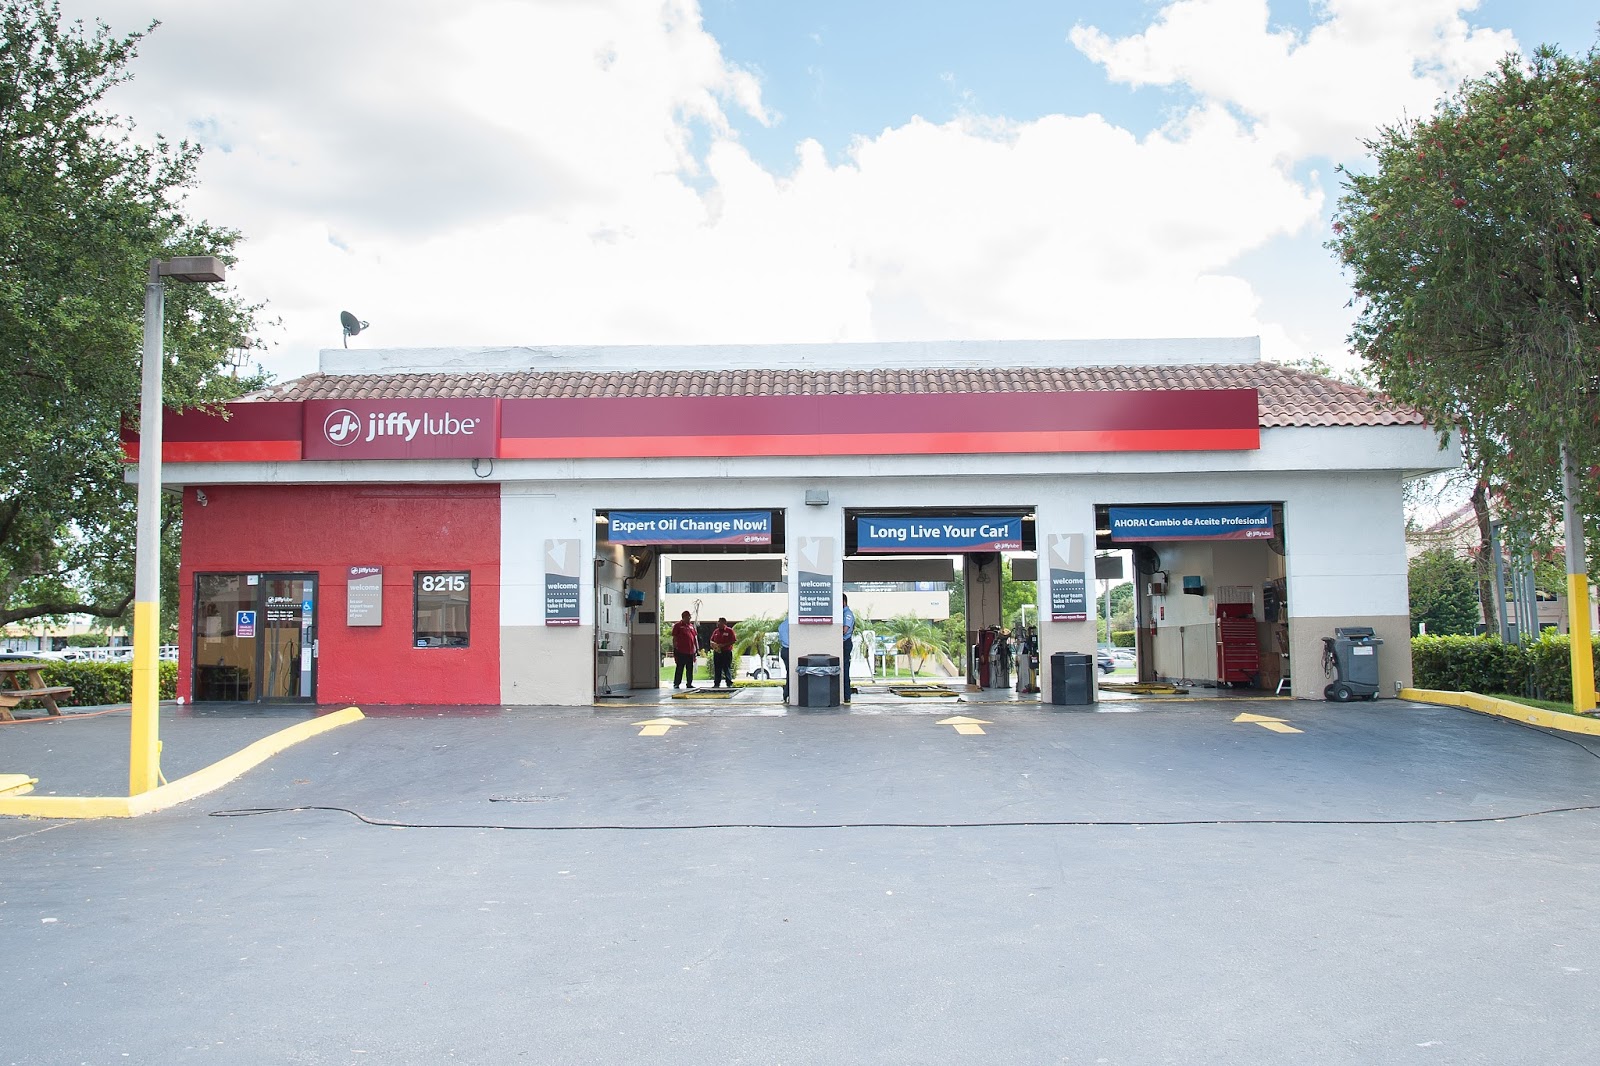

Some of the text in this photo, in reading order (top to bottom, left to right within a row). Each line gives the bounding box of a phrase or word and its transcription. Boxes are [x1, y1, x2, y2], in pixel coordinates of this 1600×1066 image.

[612, 518, 768, 533] Expert Oil Change Now!
[1114, 516, 1268, 527] AHORA! Cambio de Aceite Profesional
[870, 524, 1009, 541] Long Live Your Car!
[422, 576, 466, 592] 8215
